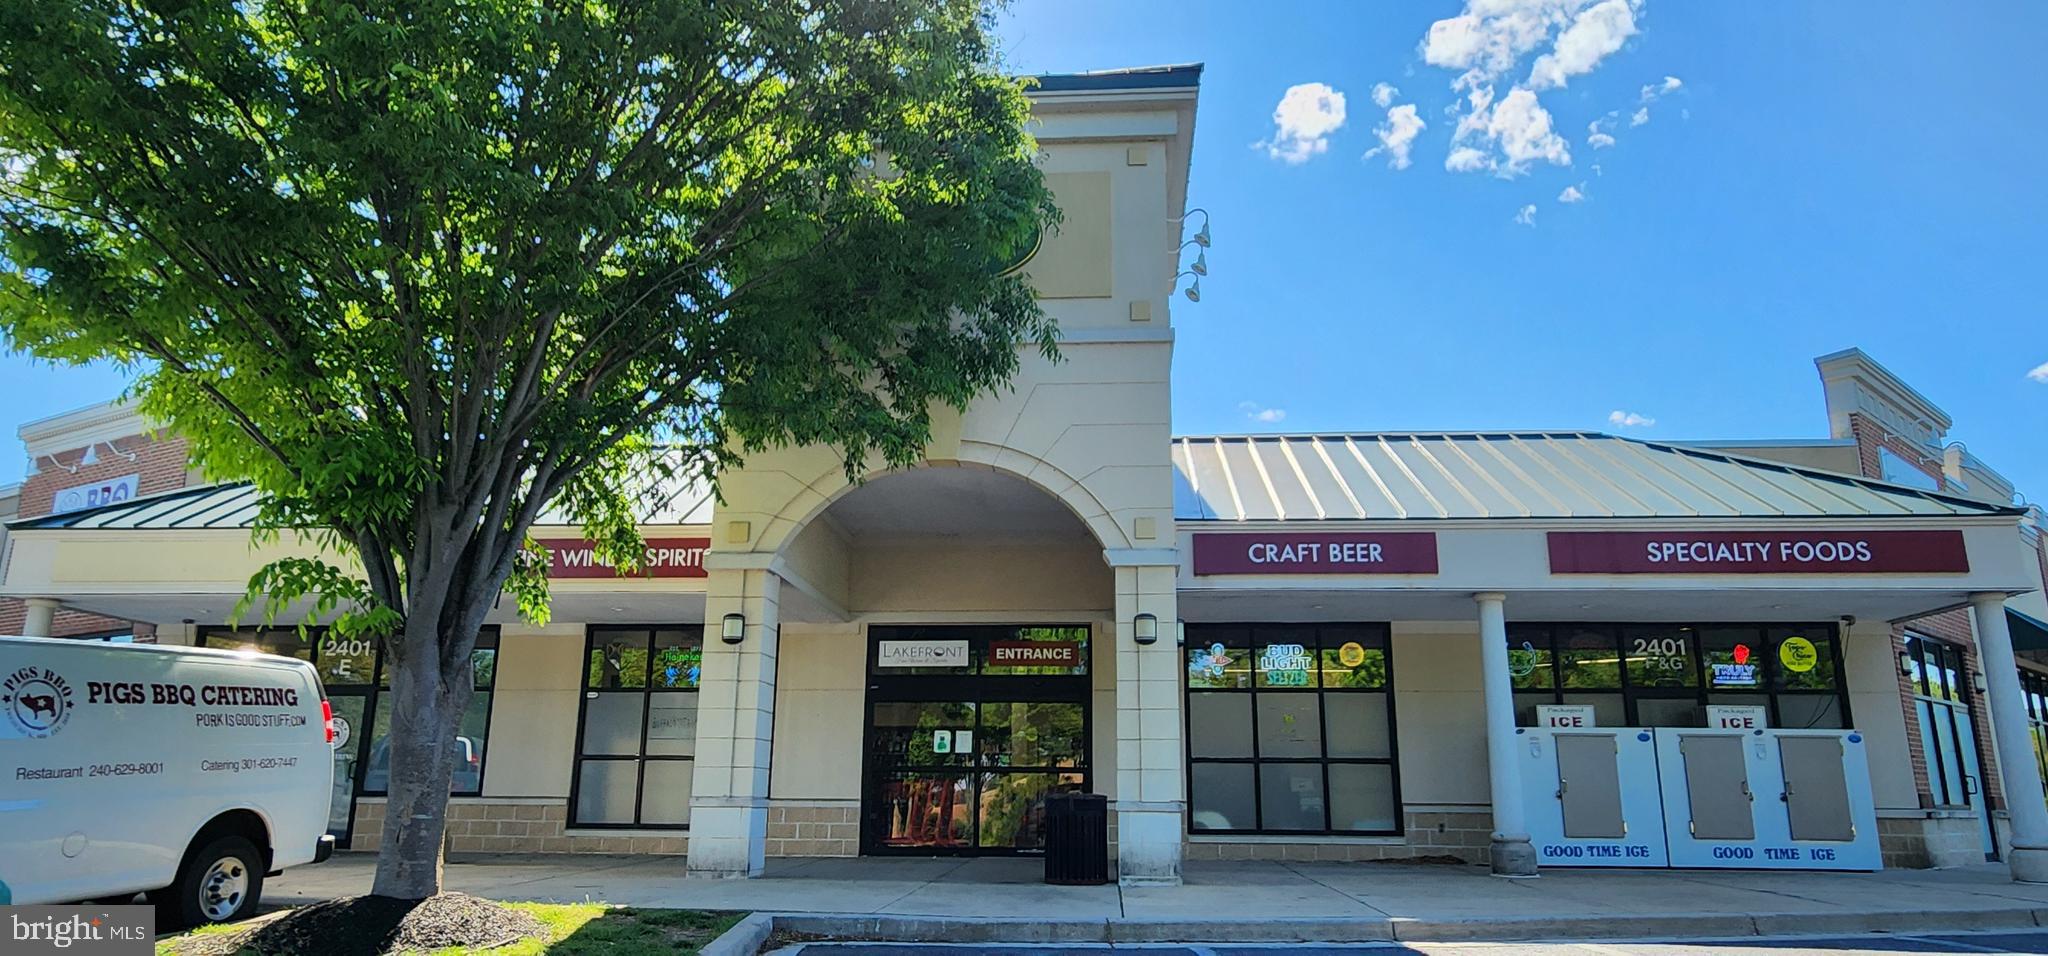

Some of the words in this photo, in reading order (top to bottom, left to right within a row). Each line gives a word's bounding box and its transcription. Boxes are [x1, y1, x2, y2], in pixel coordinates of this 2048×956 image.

[1249, 543, 1321, 563] CRAFT
[1329, 543, 1383, 562] BEER
[1647, 542, 1771, 562] SPECIALTY
[1780, 541, 1872, 562] FOODS
[325, 640, 370, 657] 2401
[883, 643, 964, 658] LAKEFRONT
[996, 648, 1072, 660] ENTRANCE
[1267, 645, 1304, 657] BUD
[1634, 638, 1686, 656] 2401
[339, 659, 352, 675] E
[1261, 656, 1312, 669] LIGHT
[1712, 664, 1756, 676] TRULY
[3, 666, 38, 691] PIGS
[87, 682, 145, 704] PIGS
[151, 684, 196, 706] BBQ
[201, 685, 298, 706] CATERING
[1550, 717, 1583, 728] ICE
[1721, 717, 1754, 729] ICE
[16, 767, 83, 780] Restaurant
[89, 763, 164, 777] 240-629-8001
[201, 760, 239, 773] Catering
[241, 757, 298, 770] 301-620-7447
[1543, 845, 1583, 857] GOOD
[1586, 845, 1622, 858] TIME
[1712, 846, 1753, 859] GOOD
[1763, 848, 1801, 860] TIME
